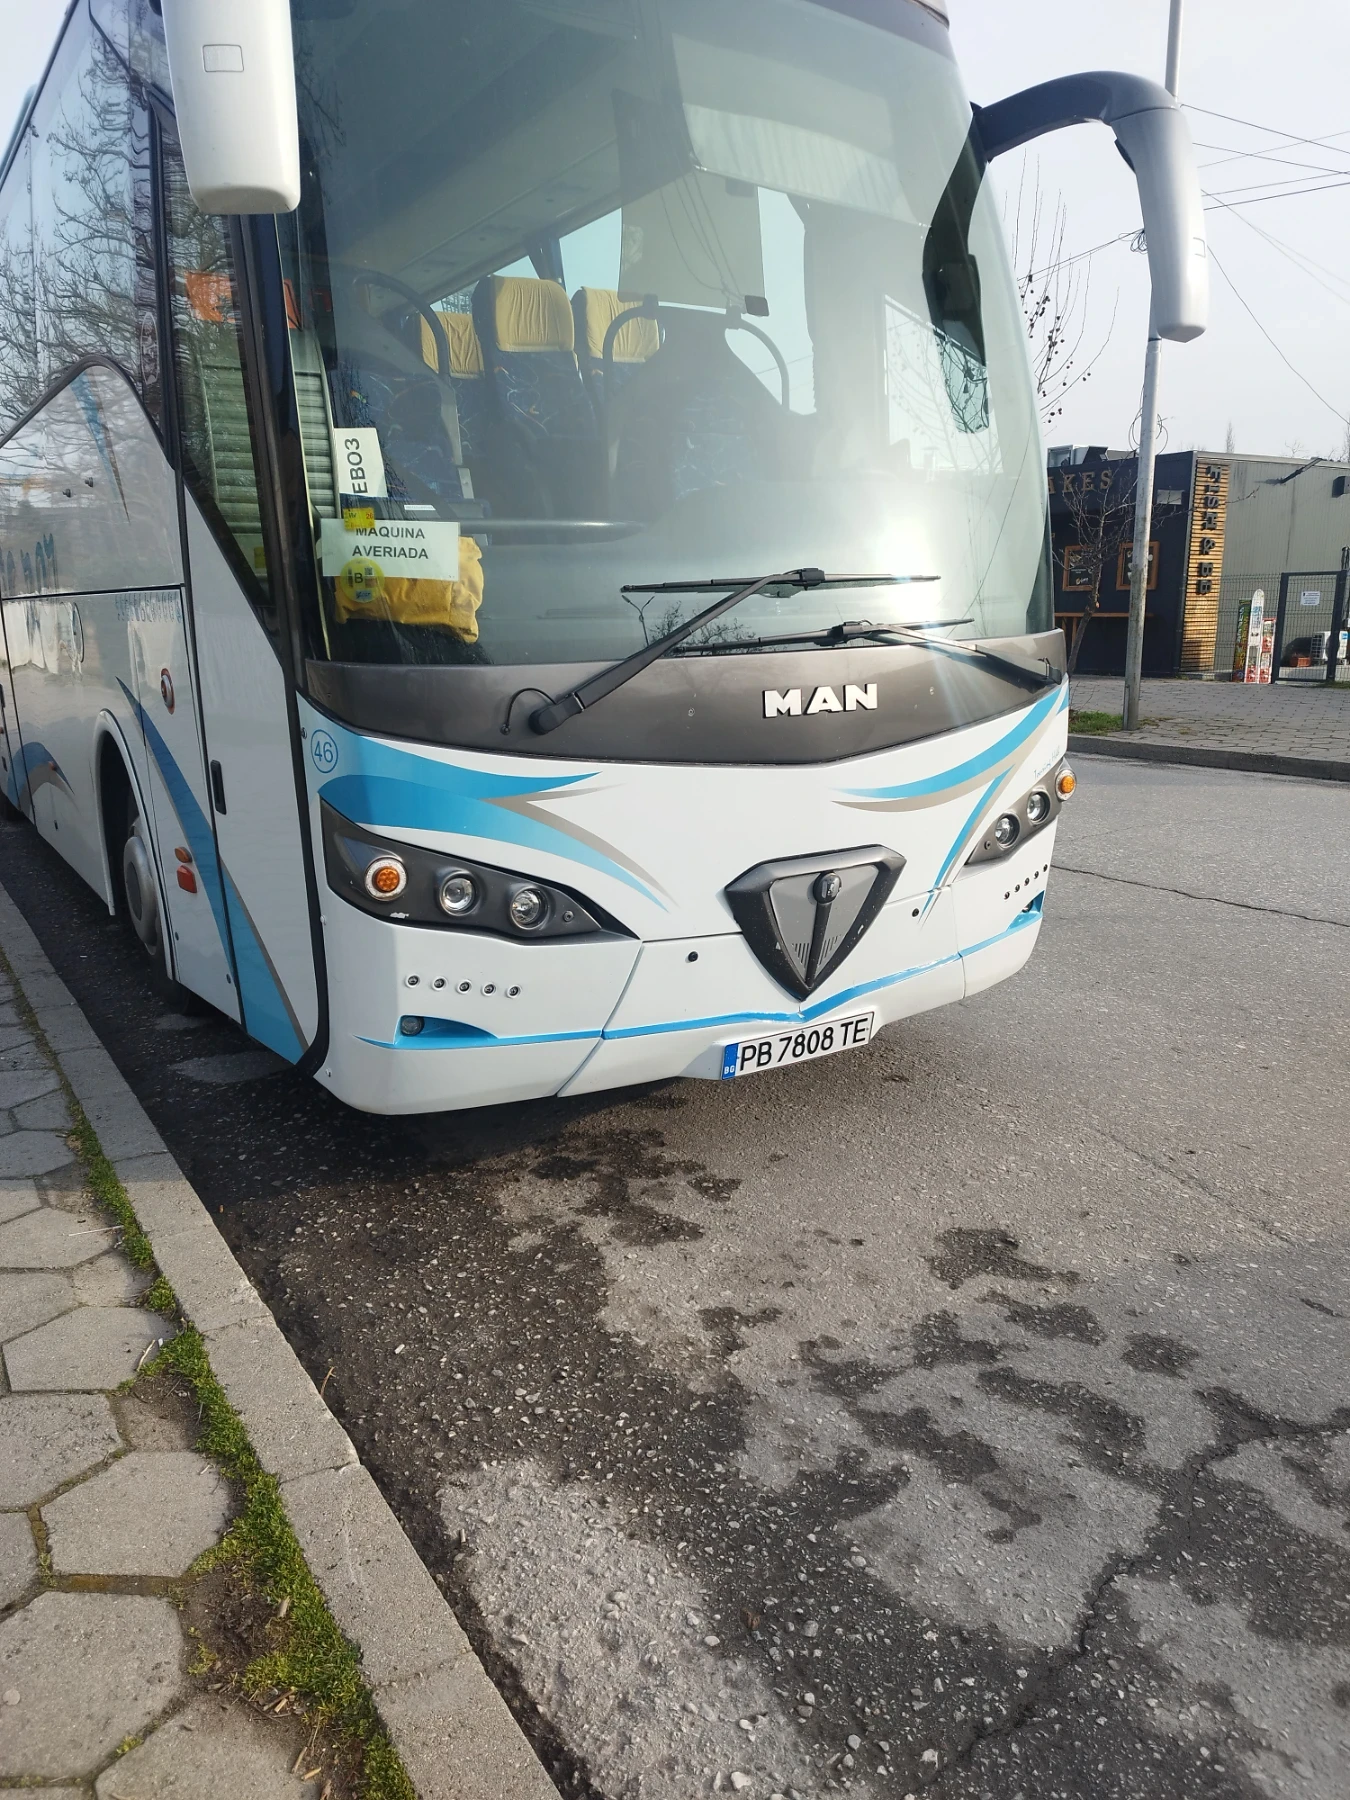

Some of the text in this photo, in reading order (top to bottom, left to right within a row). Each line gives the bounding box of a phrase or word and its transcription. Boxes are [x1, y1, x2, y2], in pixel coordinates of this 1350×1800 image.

[1203, 465, 1221, 531] FISH
[355, 526, 425, 540] MAQUINA
[352, 545, 429, 560] AVERIADA
[354, 572, 364, 584] B
[763, 683, 878, 718] MAN
[314, 740, 334, 763] 46
[740, 1018, 868, 1071] PB 7808 TE
[724, 1065, 735, 1074] BG
